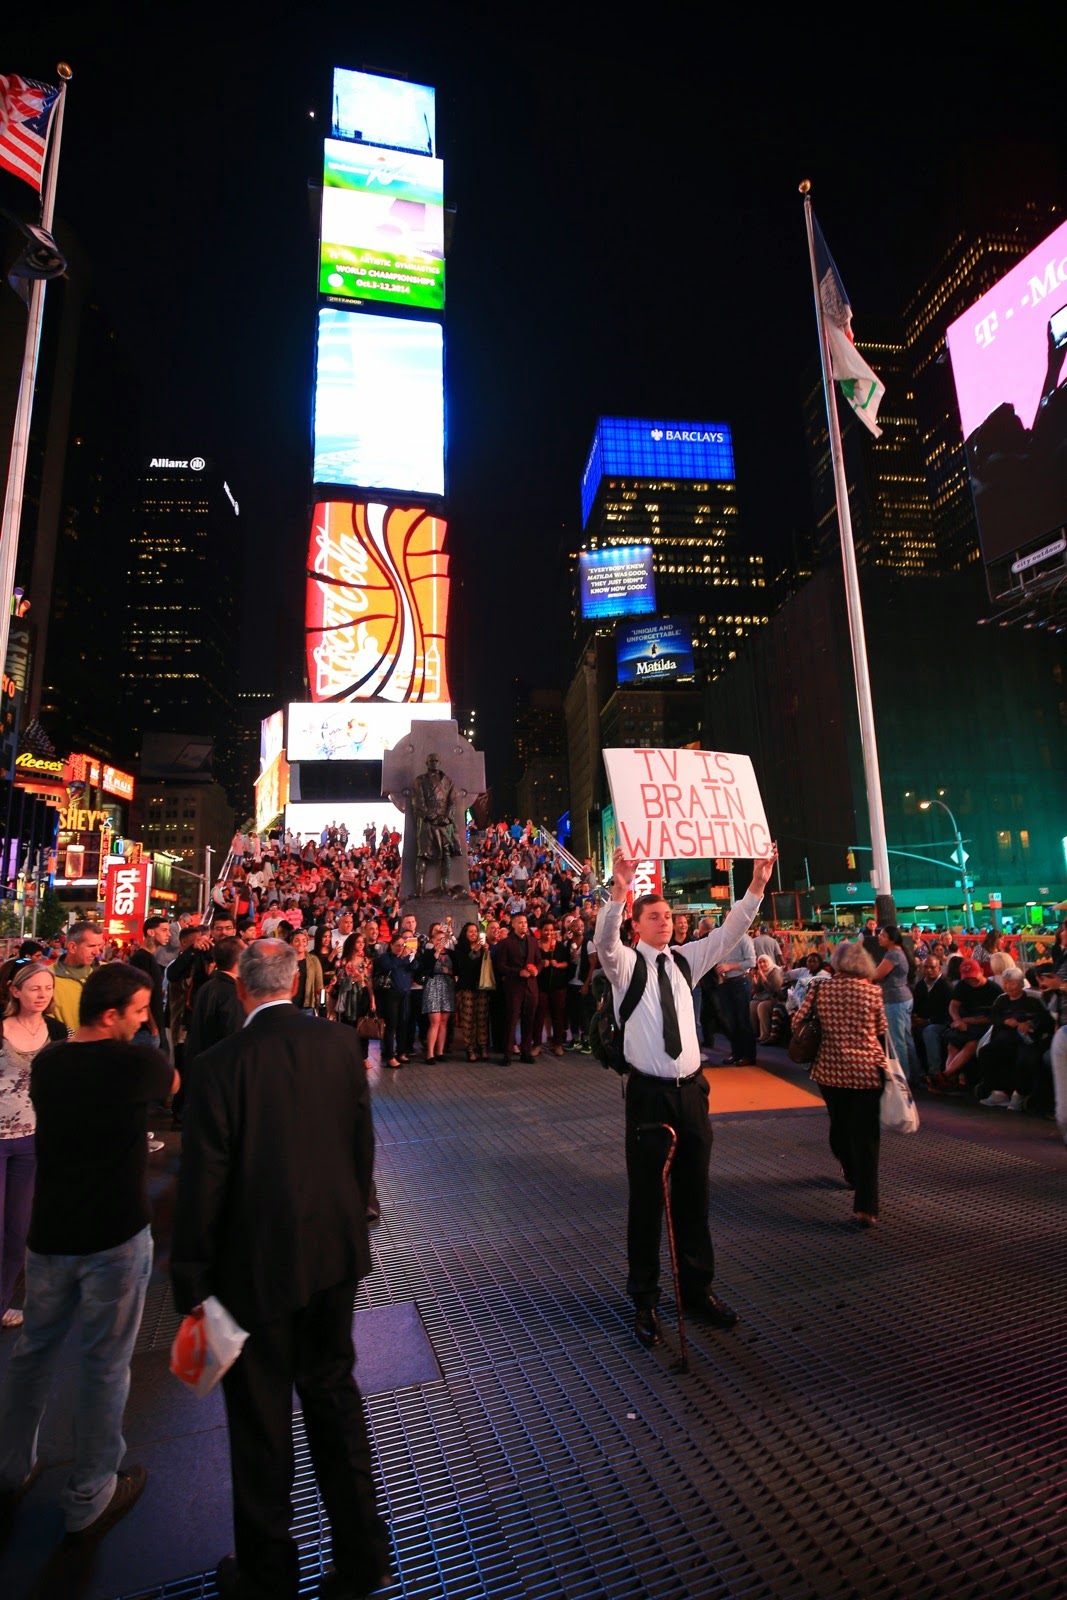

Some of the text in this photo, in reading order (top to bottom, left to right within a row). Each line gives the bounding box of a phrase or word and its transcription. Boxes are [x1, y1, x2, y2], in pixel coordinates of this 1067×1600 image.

[335, 264, 436, 287] WORLD CHAMPIONSHIPS
[394, 261, 441, 275] GYMNASTICS
[665, 430, 724, 443] BARCLAYS
[149, 457, 189, 469] Allianz
[1016, 543, 1062, 569] city outdoor
[626, 562, 645, 571] KNEW
[587, 573, 613, 581] MATILDA
[591, 580, 607, 588] THEY
[607, 578, 622, 586] JUST
[590, 586, 610, 595] KNOW
[658, 624, 674, 632] AND
[636, 658, 677, 676] Matilda
[15, 752, 64, 772] Reese's
[633, 749, 736, 785] TV IS
[639, 783, 747, 820] BRAIN
[619, 820, 772, 858] WASHING
[114, 867, 142, 916] tkts
